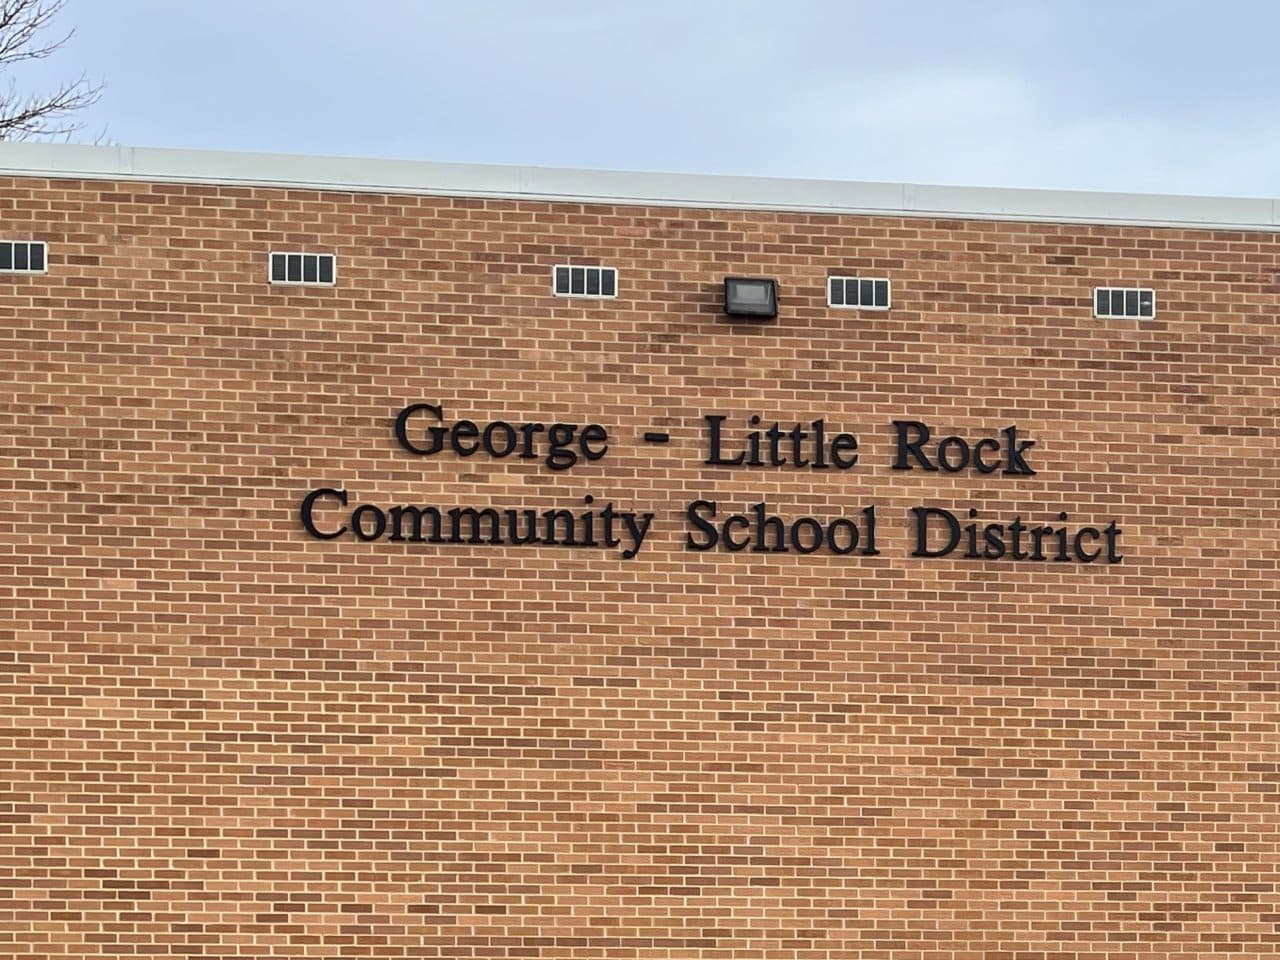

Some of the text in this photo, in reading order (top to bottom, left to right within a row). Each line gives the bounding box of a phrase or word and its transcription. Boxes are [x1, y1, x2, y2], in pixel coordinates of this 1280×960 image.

[395, 403, 1036, 475] George - Little Rock
[300, 488, 1123, 563] Community School District
